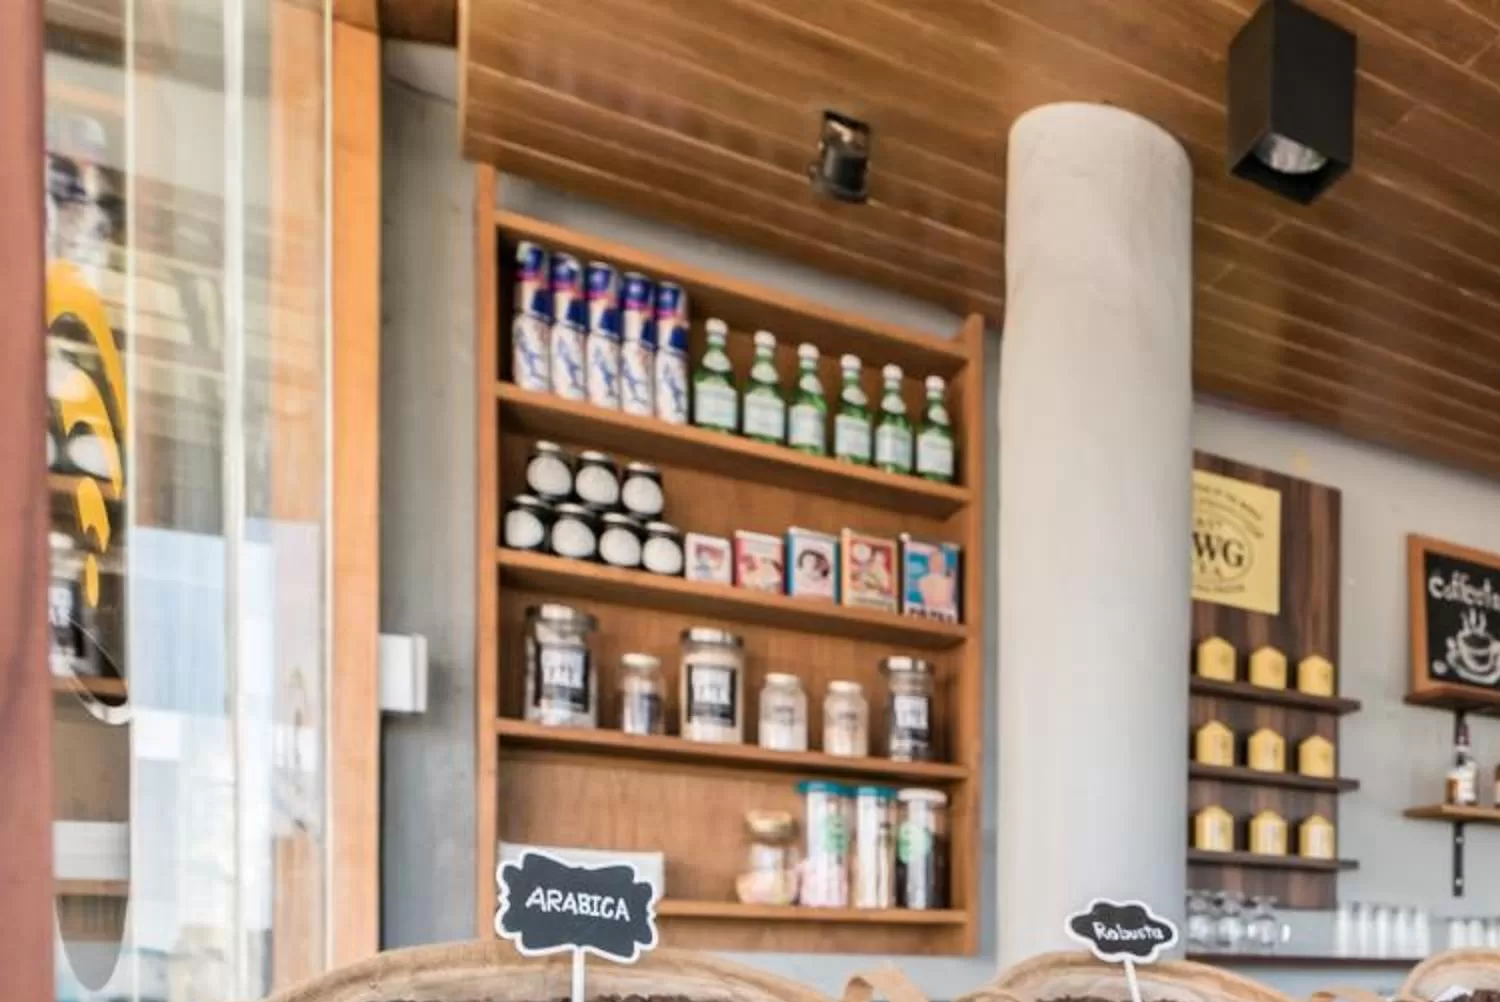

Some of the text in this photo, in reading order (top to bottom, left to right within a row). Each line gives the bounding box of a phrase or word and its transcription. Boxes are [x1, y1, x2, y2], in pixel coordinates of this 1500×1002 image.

[1193, 531, 1245, 568] WG
[525, 886, 631, 923] ARABICA
[1092, 920, 1165, 942] Robusta
